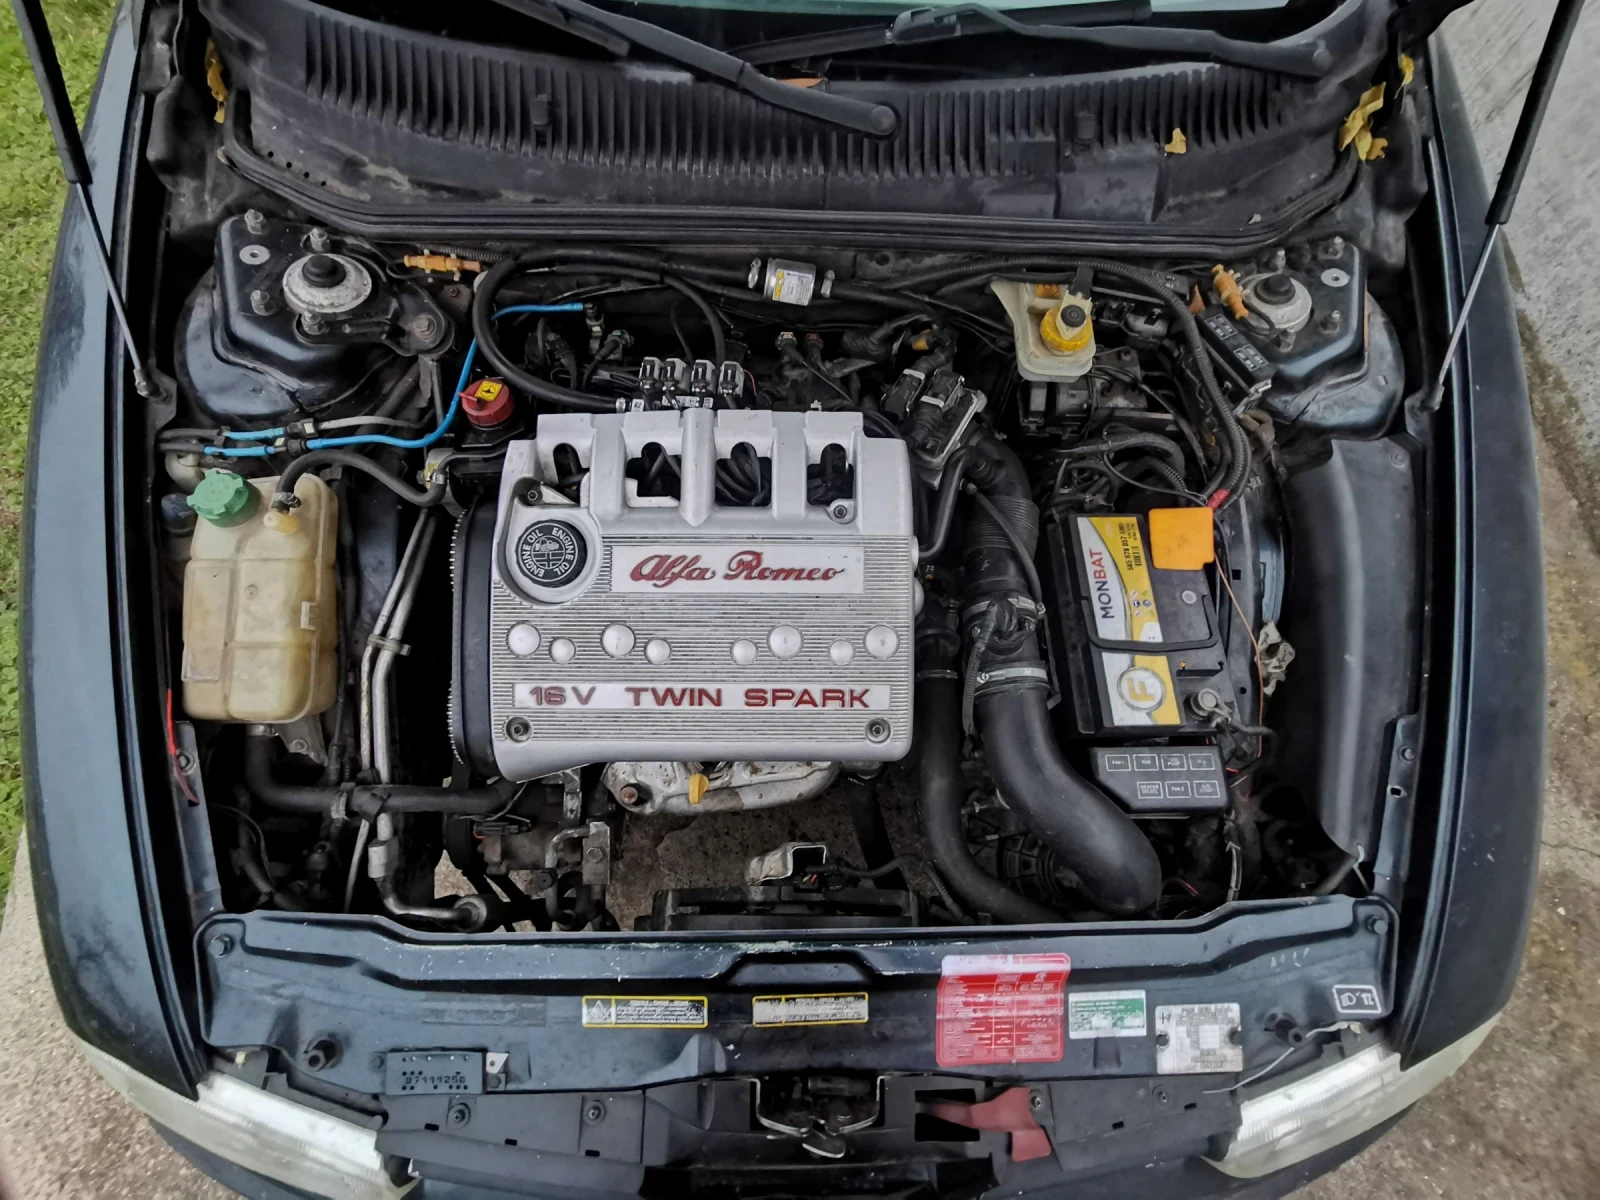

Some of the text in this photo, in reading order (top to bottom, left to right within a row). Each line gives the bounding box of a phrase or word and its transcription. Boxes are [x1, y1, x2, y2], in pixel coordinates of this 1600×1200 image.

[521, 529, 546, 578] ENGINE OIL
[551, 527, 575, 576] ENGINE OIL
[629, 550, 846, 589] Alfa Romeo
[1089, 546, 1115, 619] MONBAT
[624, 687, 723, 707] TWIN
[743, 687, 870, 708] SPARK
